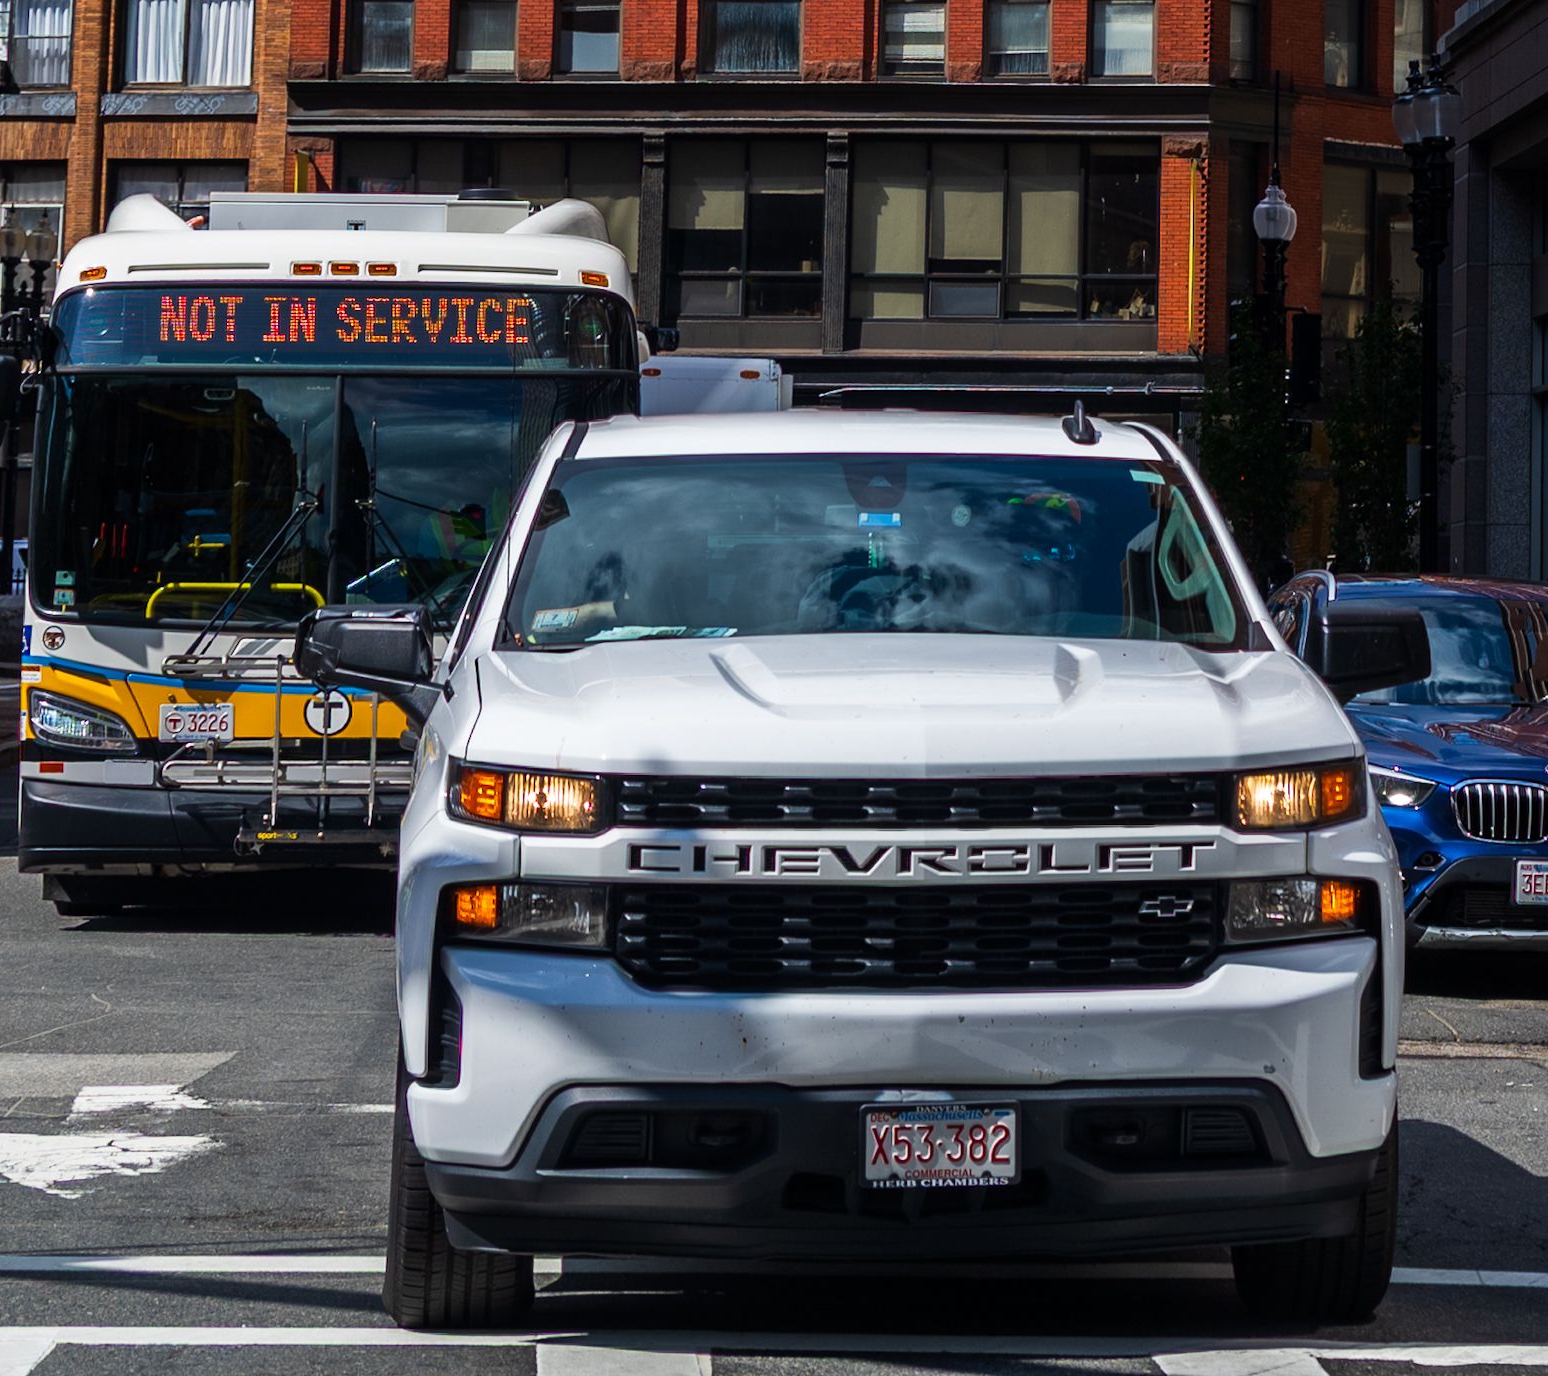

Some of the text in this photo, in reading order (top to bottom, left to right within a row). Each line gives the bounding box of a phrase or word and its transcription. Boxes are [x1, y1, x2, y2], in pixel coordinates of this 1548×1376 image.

[159, 296, 530, 343] NOT IN SERVICE
[188, 712, 229, 732] 3226
[627, 841, 1217, 876] CHEVROLET
[916, 1104, 968, 1113] DANVERS
[870, 1110, 984, 1123] DEC Massachusetts
[905, 1168, 975, 1179] COMMERCIAL
[872, 1177, 1009, 1188] HERB CHAMBERS
